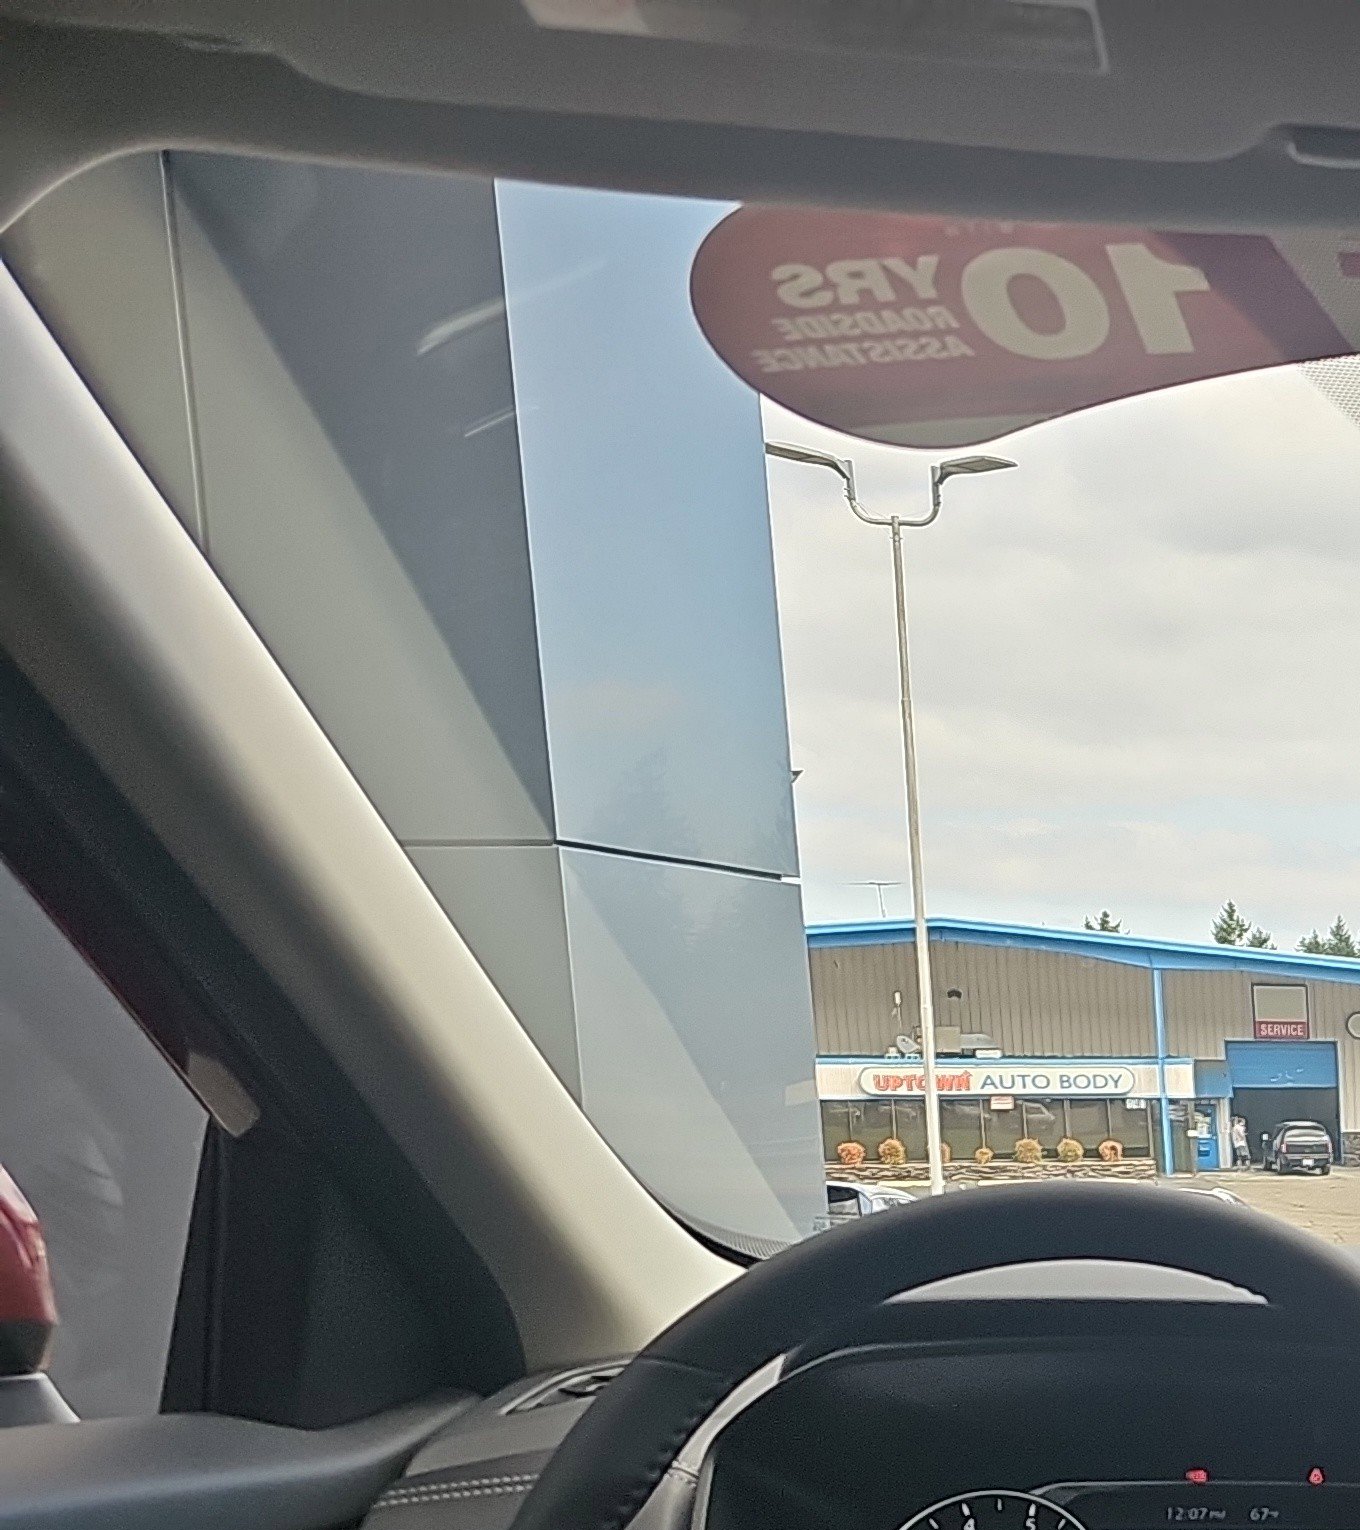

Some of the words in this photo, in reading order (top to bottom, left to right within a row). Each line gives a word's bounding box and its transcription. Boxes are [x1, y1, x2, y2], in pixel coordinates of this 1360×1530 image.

[1260, 1023, 1304, 1036] SERVICE
[980, 1074, 1050, 1090] AUTO
[1059, 1074, 1123, 1090] BODY
